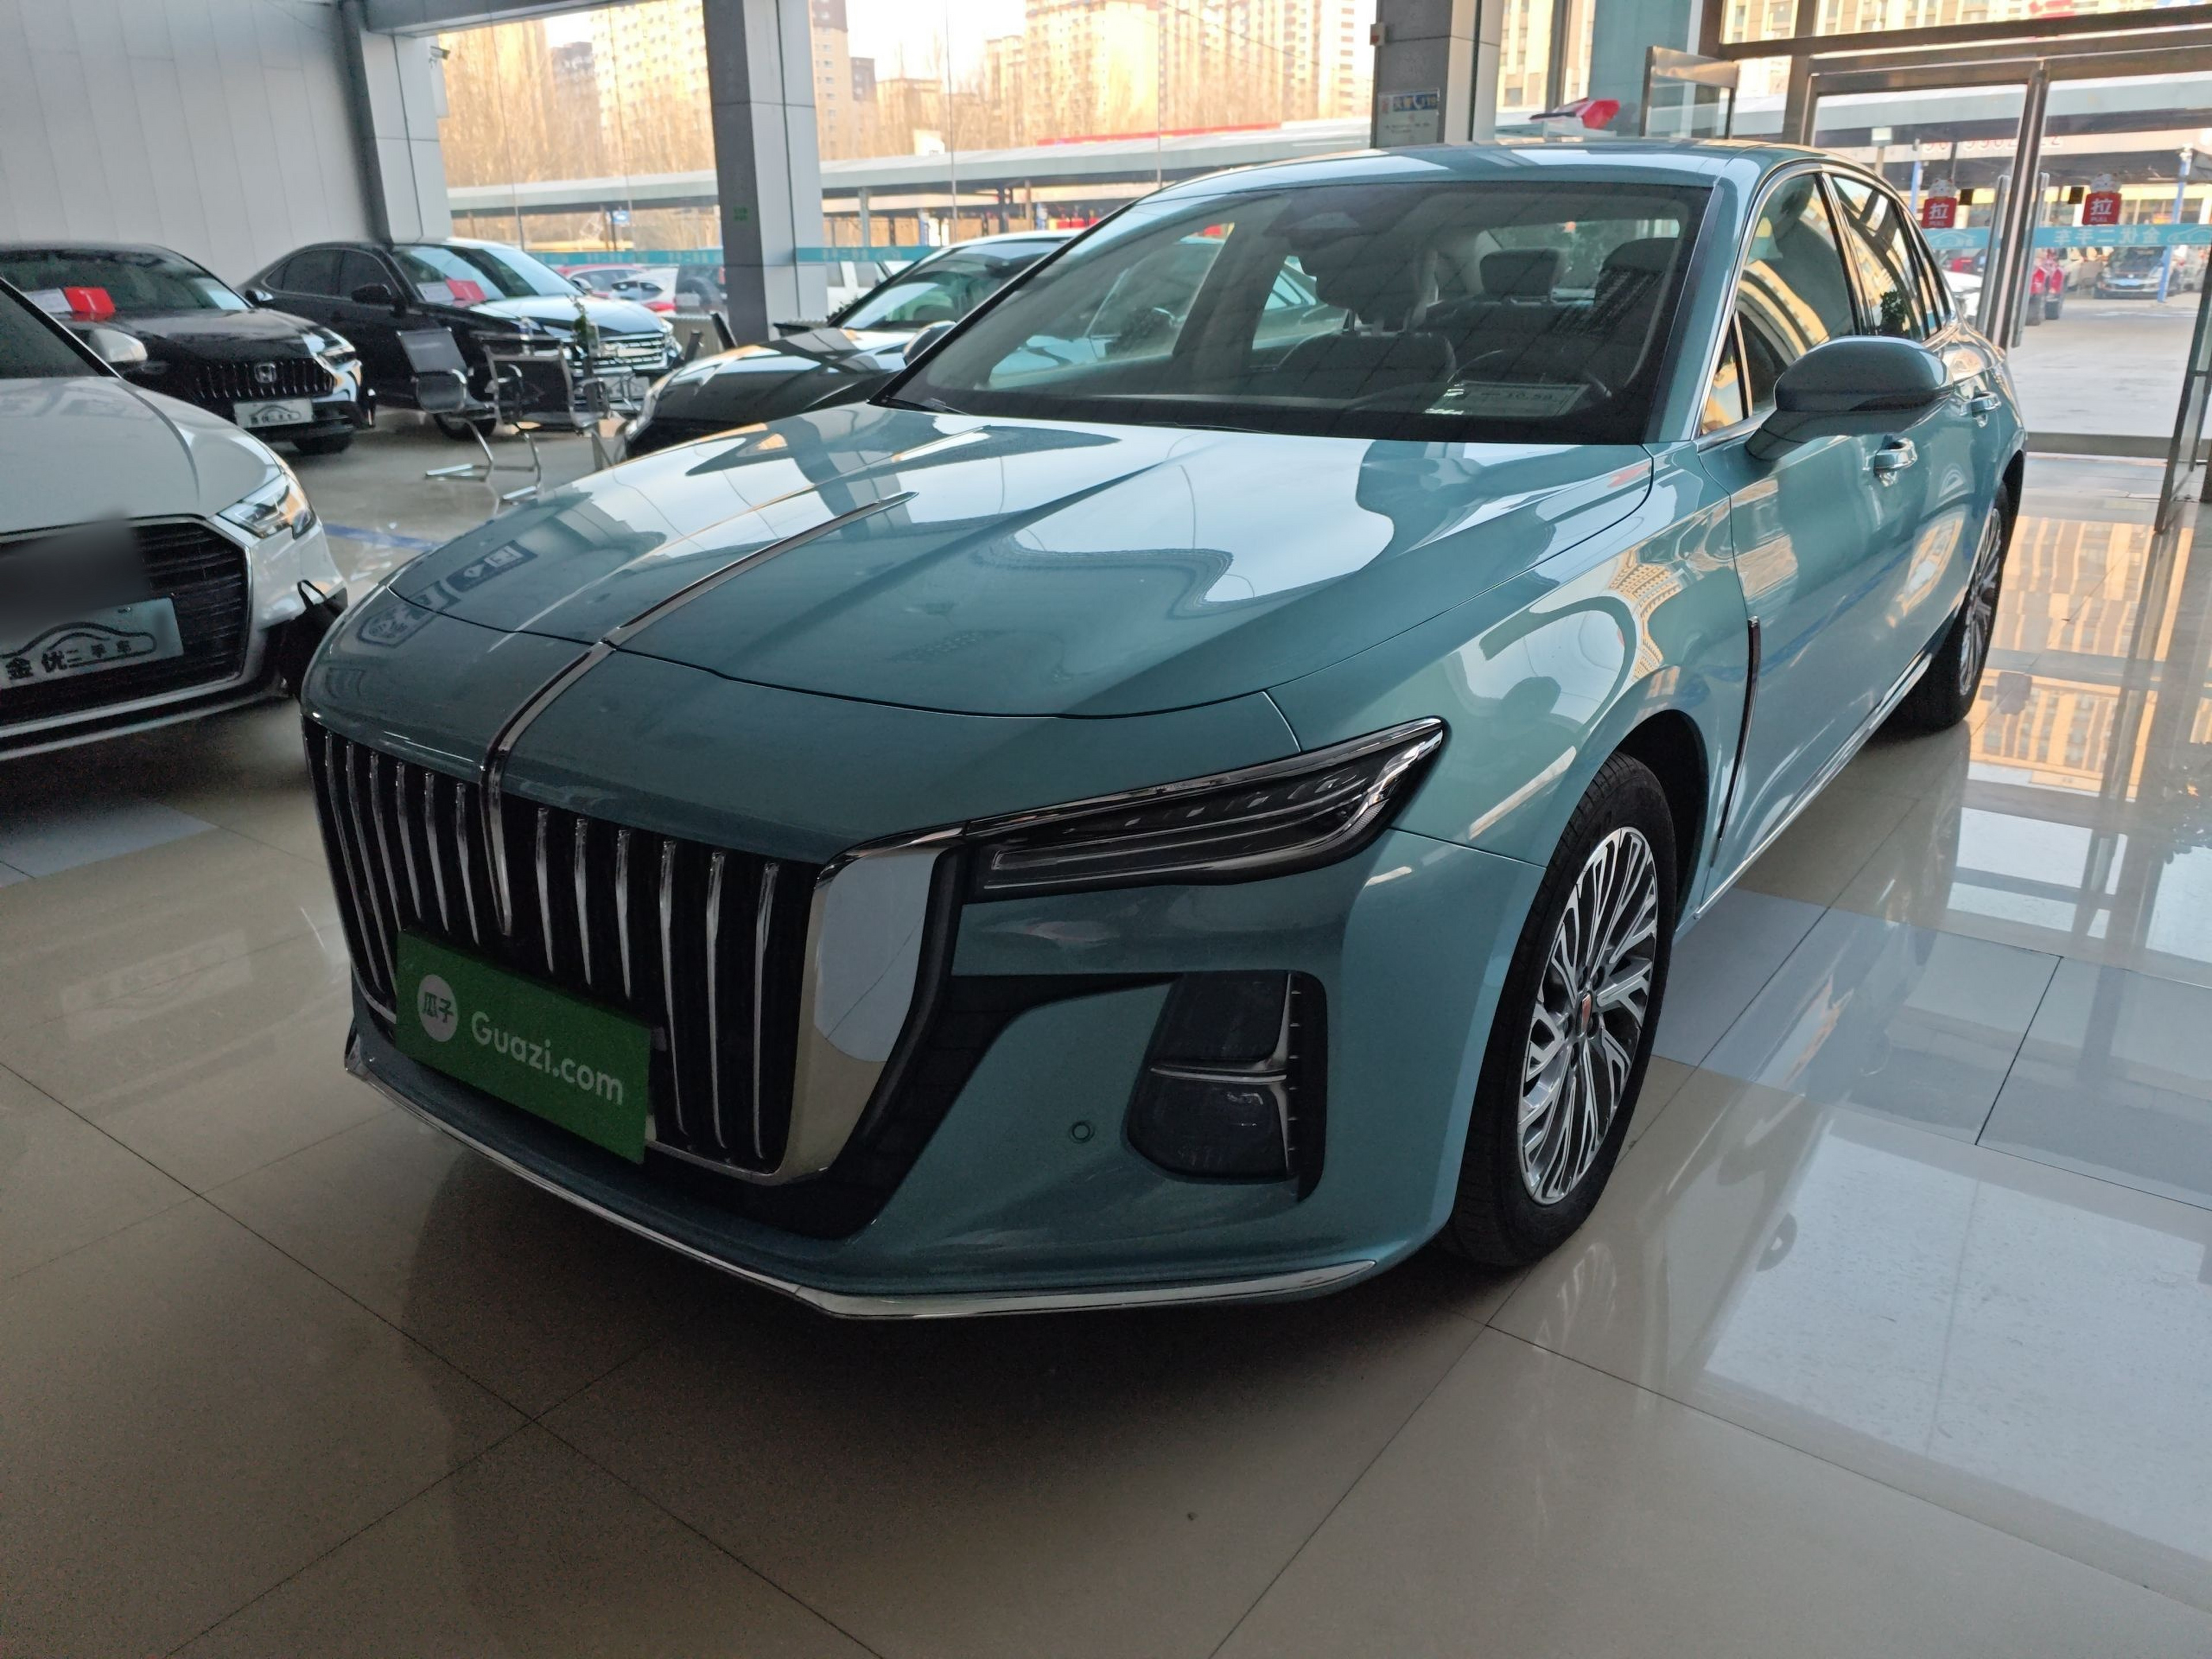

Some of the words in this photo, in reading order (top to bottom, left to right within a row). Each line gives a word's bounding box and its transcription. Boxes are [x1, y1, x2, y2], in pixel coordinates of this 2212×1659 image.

[1929, 202, 1950, 219] 拉
[2090, 198, 2113, 215] 拉
[422, 991, 454, 1024] 瓜子
[471, 1011, 623, 1105] Guazi.com
